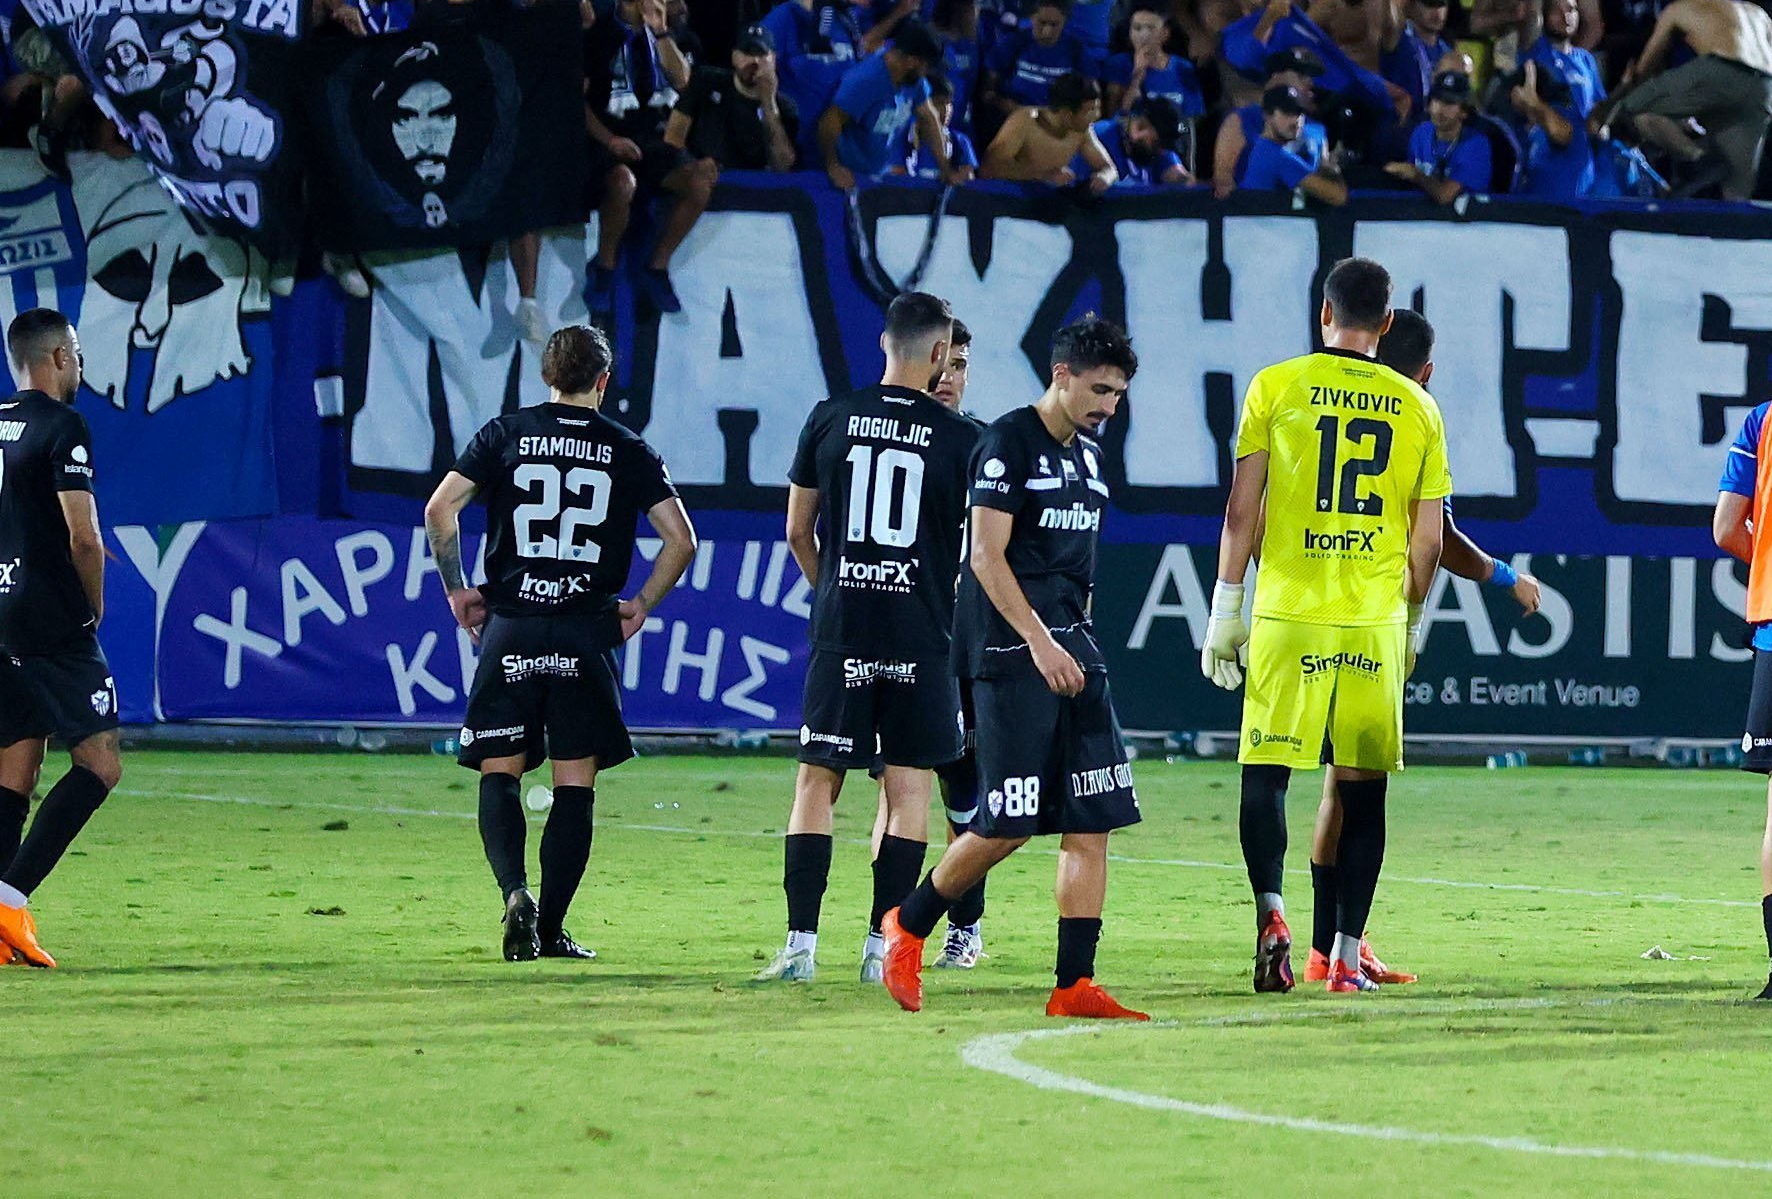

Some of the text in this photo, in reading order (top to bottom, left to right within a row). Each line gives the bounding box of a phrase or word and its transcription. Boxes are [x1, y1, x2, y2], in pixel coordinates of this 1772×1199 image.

[1310, 386, 1402, 416] ZIVKOVIC
[0, 420, 26, 442] ROU
[847, 415, 933, 447] ROGULJIC
[519, 436, 613, 464] STAMOULIS
[1315, 415, 1394, 516] 12
[845, 445, 925, 548] 10
[513, 463, 612, 564] 22
[1304, 526, 1384, 552] IronFX
[839, 556, 919, 586] IronFX
[1304, 552, 1331, 560] SOLID
[838, 580, 911, 594] SOLID TRADING
[501, 653, 579, 675] Singular
[1300, 652, 1382, 675] Singular
[1440, 676, 1461, 705] &
[1470, 677, 1549, 706] Event
[1554, 678, 1641, 707] Venue
[1003, 775, 1040, 817] 88
